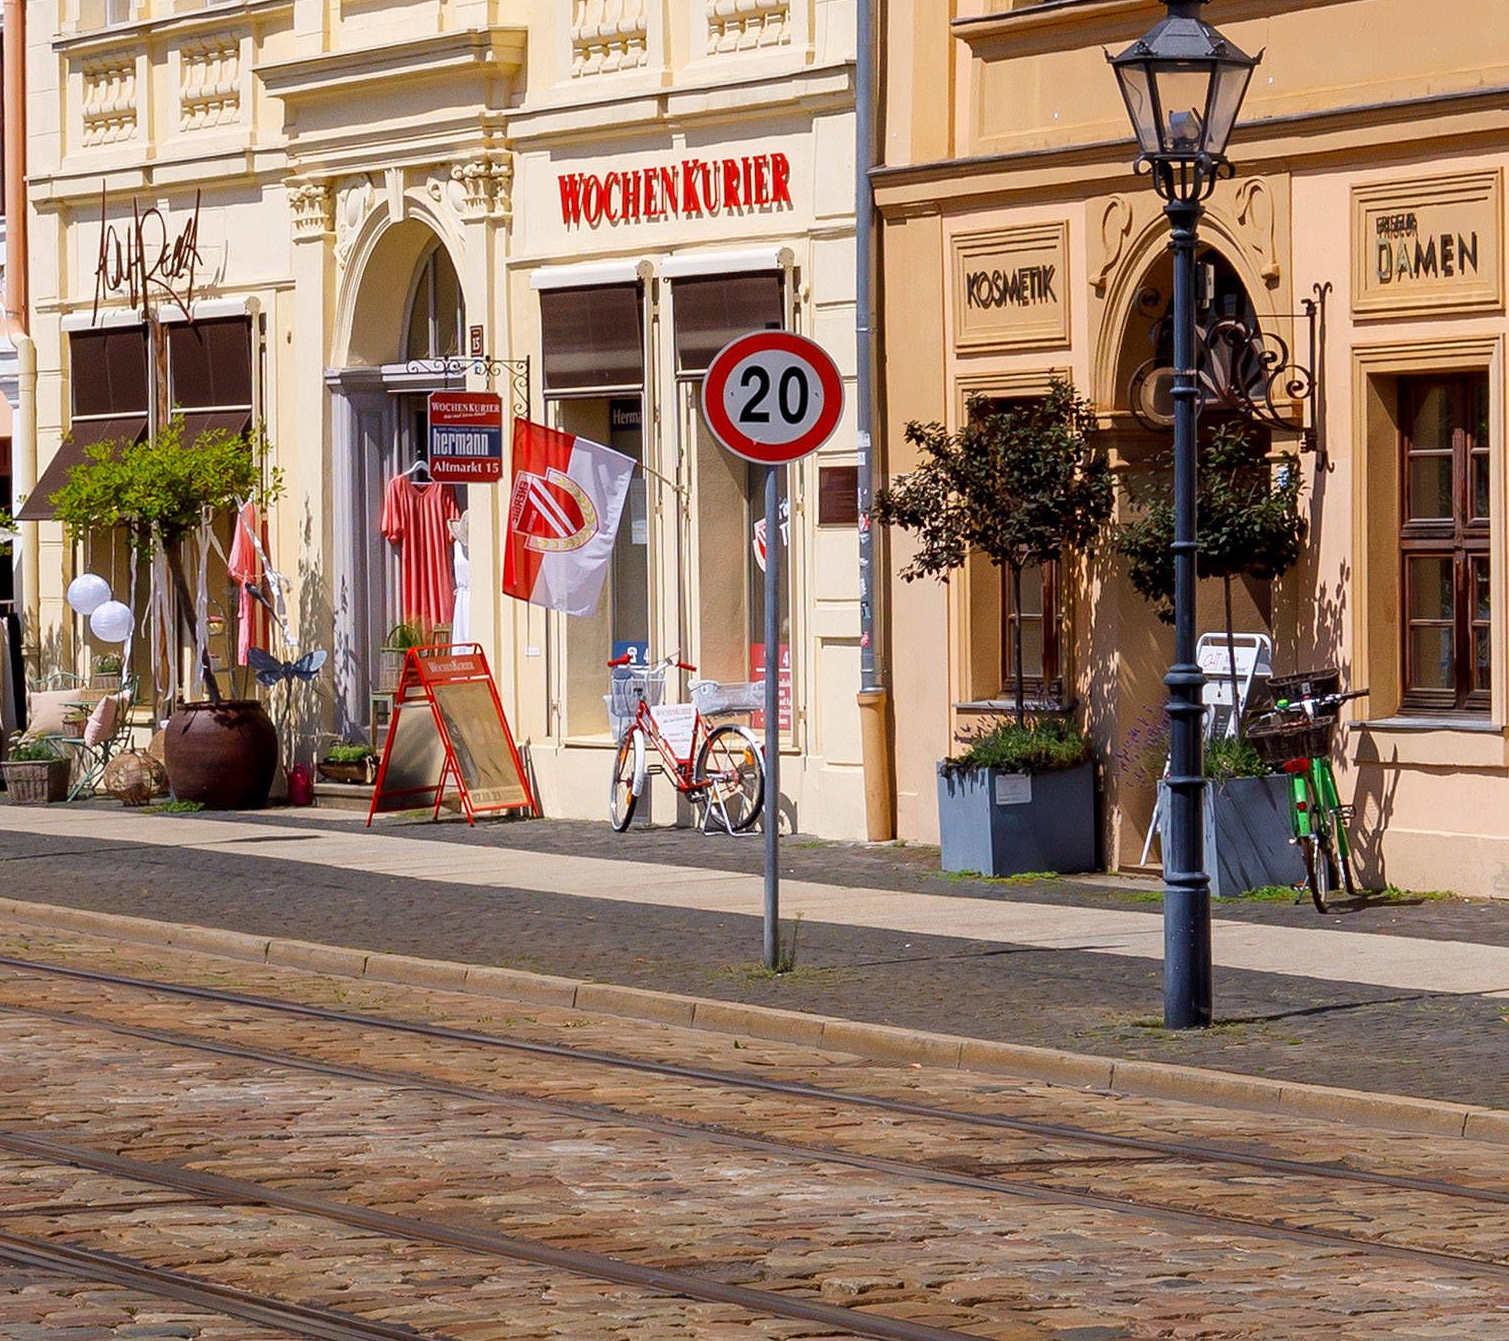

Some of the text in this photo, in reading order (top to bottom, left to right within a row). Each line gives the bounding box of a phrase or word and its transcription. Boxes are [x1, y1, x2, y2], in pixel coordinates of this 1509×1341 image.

[558, 153, 792, 227] WOCHENKURIER
[1376, 231, 1479, 285] DAMEN
[966, 264, 1058, 310] KOSMETIK
[431, 401, 500, 413] WOCHENKURIER
[739, 365, 809, 424] 20
[433, 428, 489, 456] hermann
[433, 462, 499, 474] Altmarkt 15
